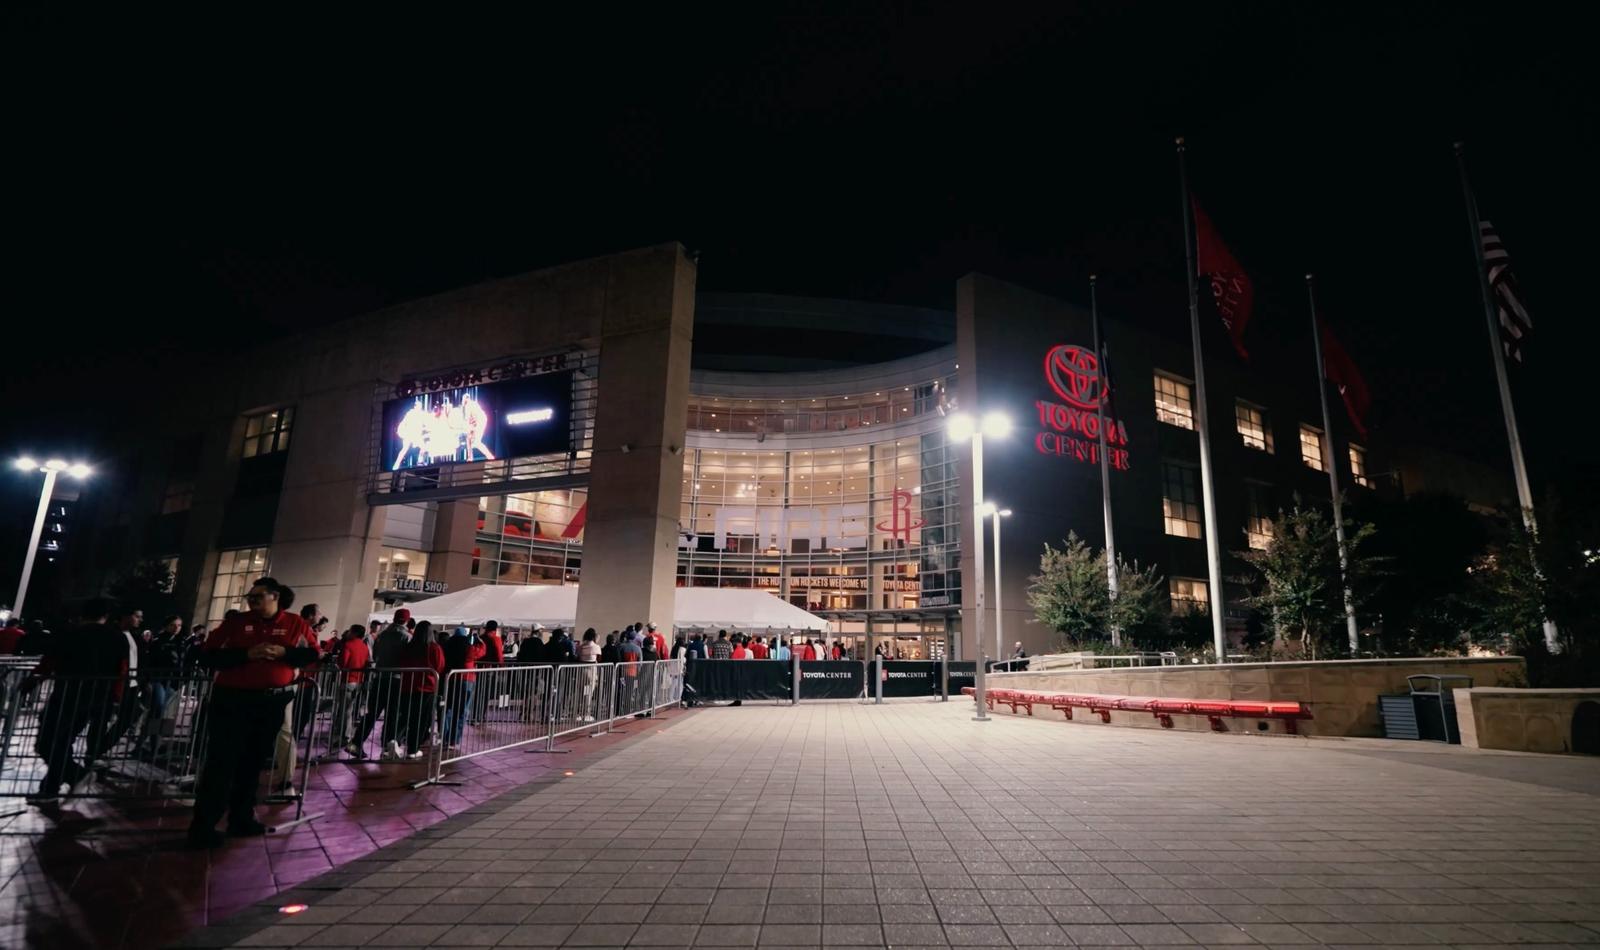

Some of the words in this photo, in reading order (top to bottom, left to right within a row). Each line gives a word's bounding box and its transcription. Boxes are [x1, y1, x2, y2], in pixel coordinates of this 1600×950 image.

[416, 368, 483, 393] TOYOTA
[487, 355, 567, 380] CENTER
[1036, 400, 1128, 445] TOYOTA
[1036, 432, 1130, 471] CENTER
[396, 578, 423, 591] TEAM
[424, 581, 448, 593] SHOP
[758, 577, 770, 586] THE
